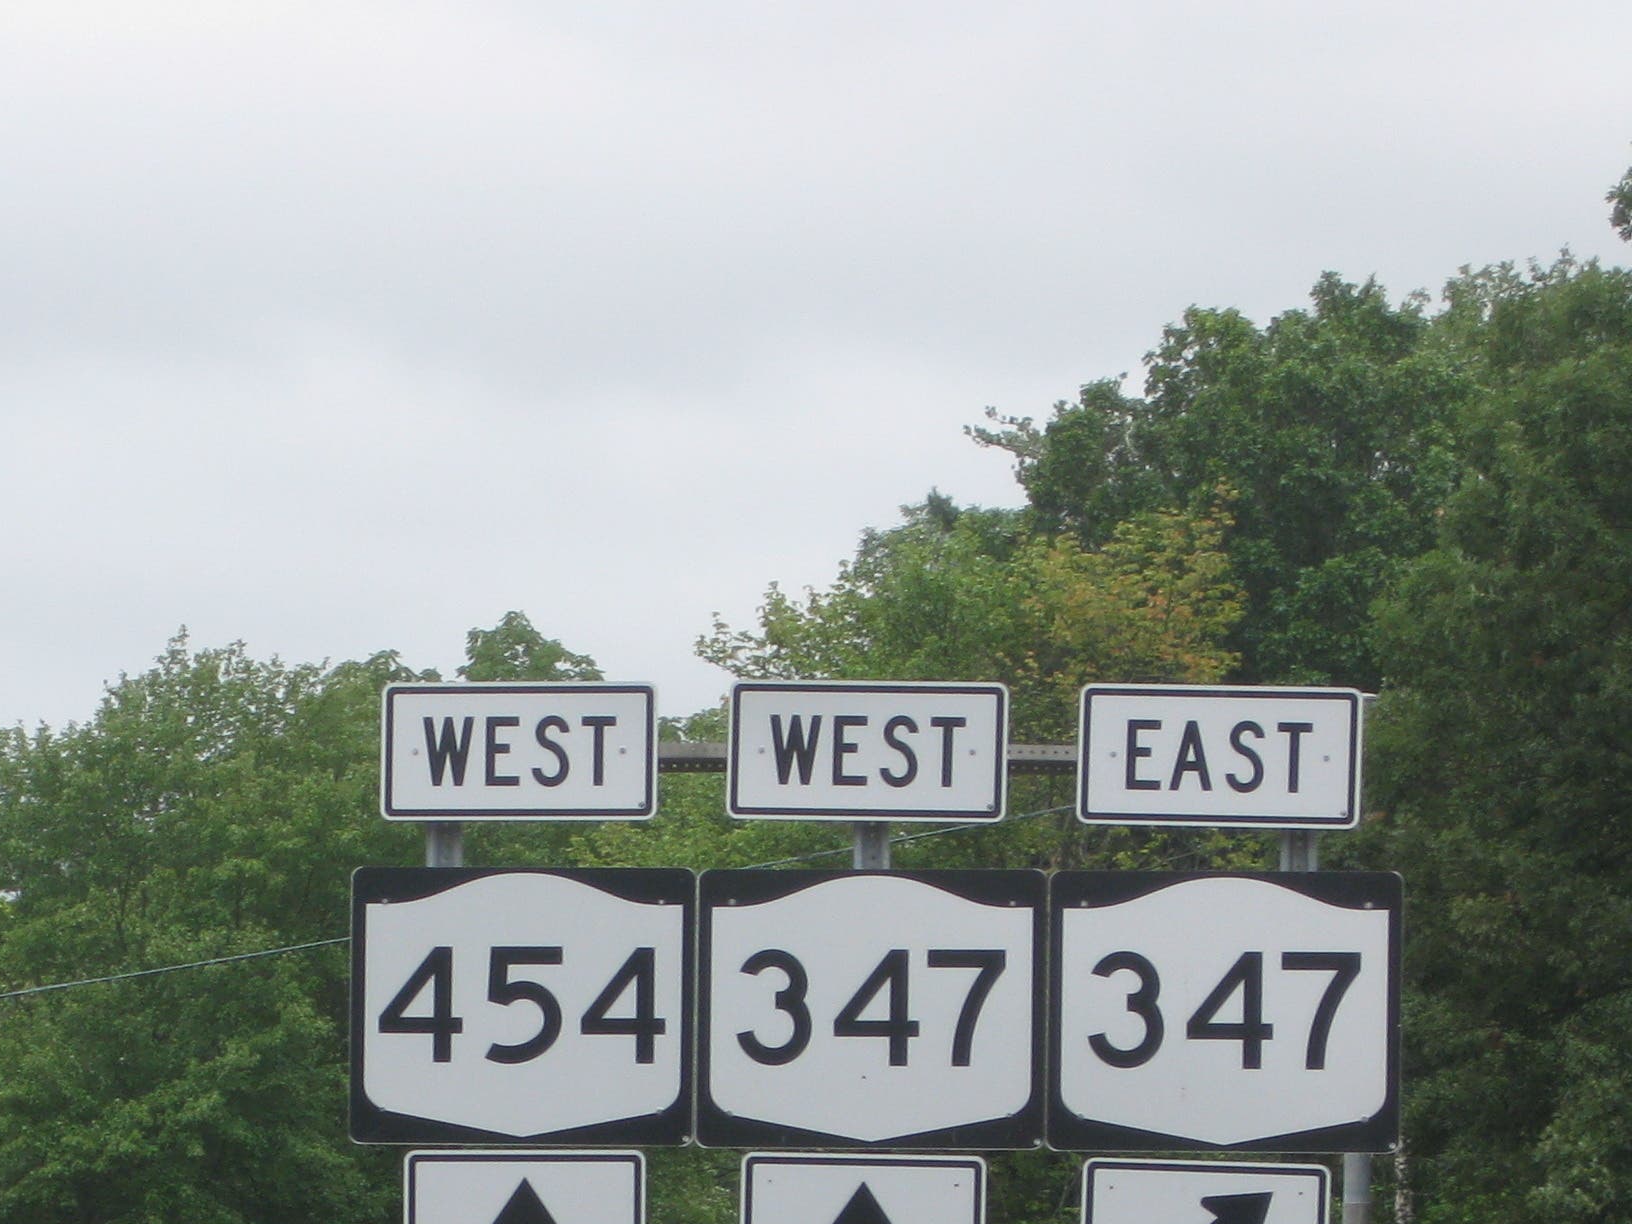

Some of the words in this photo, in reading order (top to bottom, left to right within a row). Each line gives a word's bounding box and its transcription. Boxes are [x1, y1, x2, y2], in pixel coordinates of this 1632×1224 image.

[423, 715, 617, 788] WEST
[770, 714, 966, 788] WEST
[1125, 719, 1313, 794] EAST
[378, 946, 666, 1065] 454
[736, 948, 1006, 1067] 347
[1087, 950, 1362, 1070] 347
